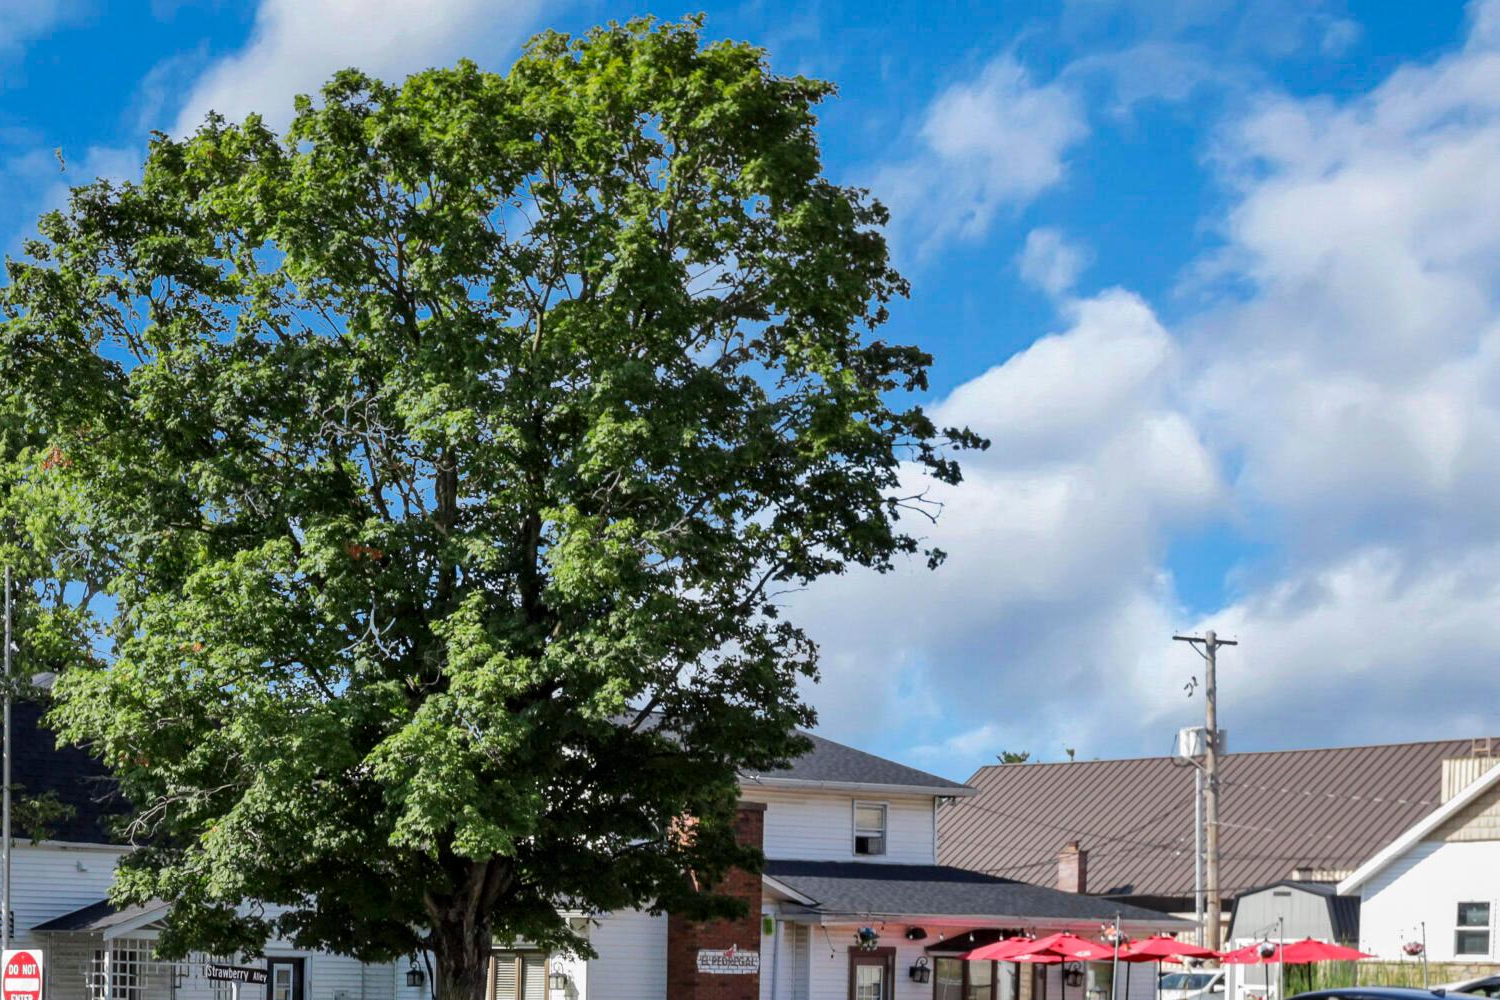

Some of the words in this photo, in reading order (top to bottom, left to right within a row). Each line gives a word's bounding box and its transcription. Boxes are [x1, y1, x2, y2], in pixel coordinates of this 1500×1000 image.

[8, 964, 19, 975] DO
[22, 964, 37, 975] NOT
[208, 965, 249, 982] Strawberry
[253, 971, 268, 983] Alley
